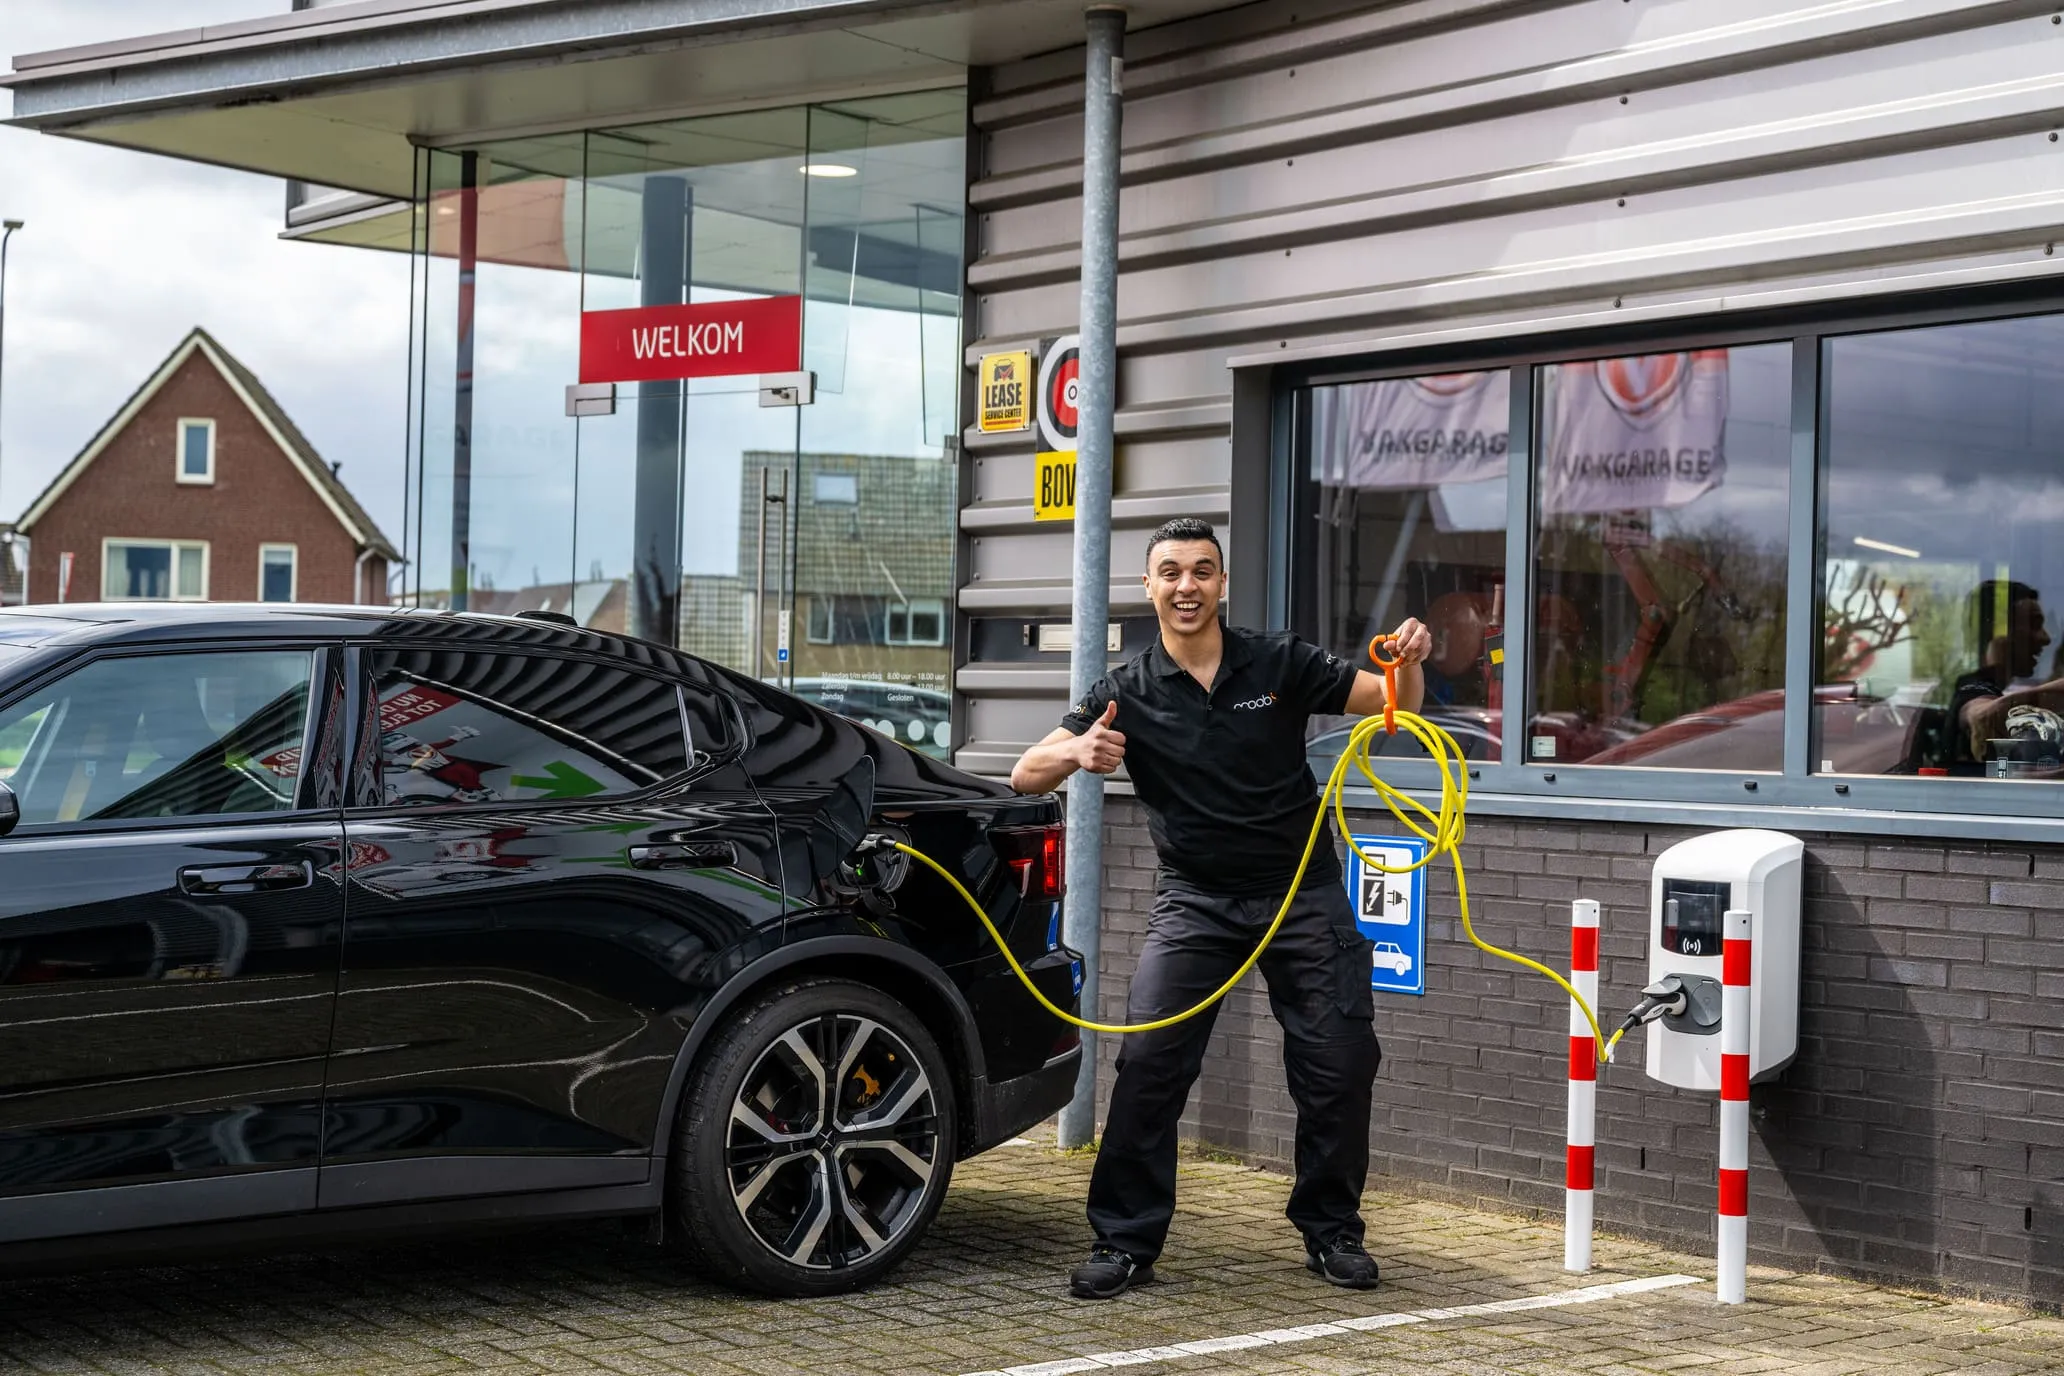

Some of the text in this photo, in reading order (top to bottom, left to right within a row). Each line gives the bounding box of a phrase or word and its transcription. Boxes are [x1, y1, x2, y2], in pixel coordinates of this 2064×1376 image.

[632, 321, 743, 360] WELKOM
[985, 382, 1022, 409] LEASE
[985, 408, 1022, 420] SERVICE CENTER
[1562, 447, 1713, 482] VAKGARAGE
[1041, 463, 1077, 508] BOV
[821, 692, 914, 702] Zondag Gesloten
[1233, 691, 1277, 710] moobi
